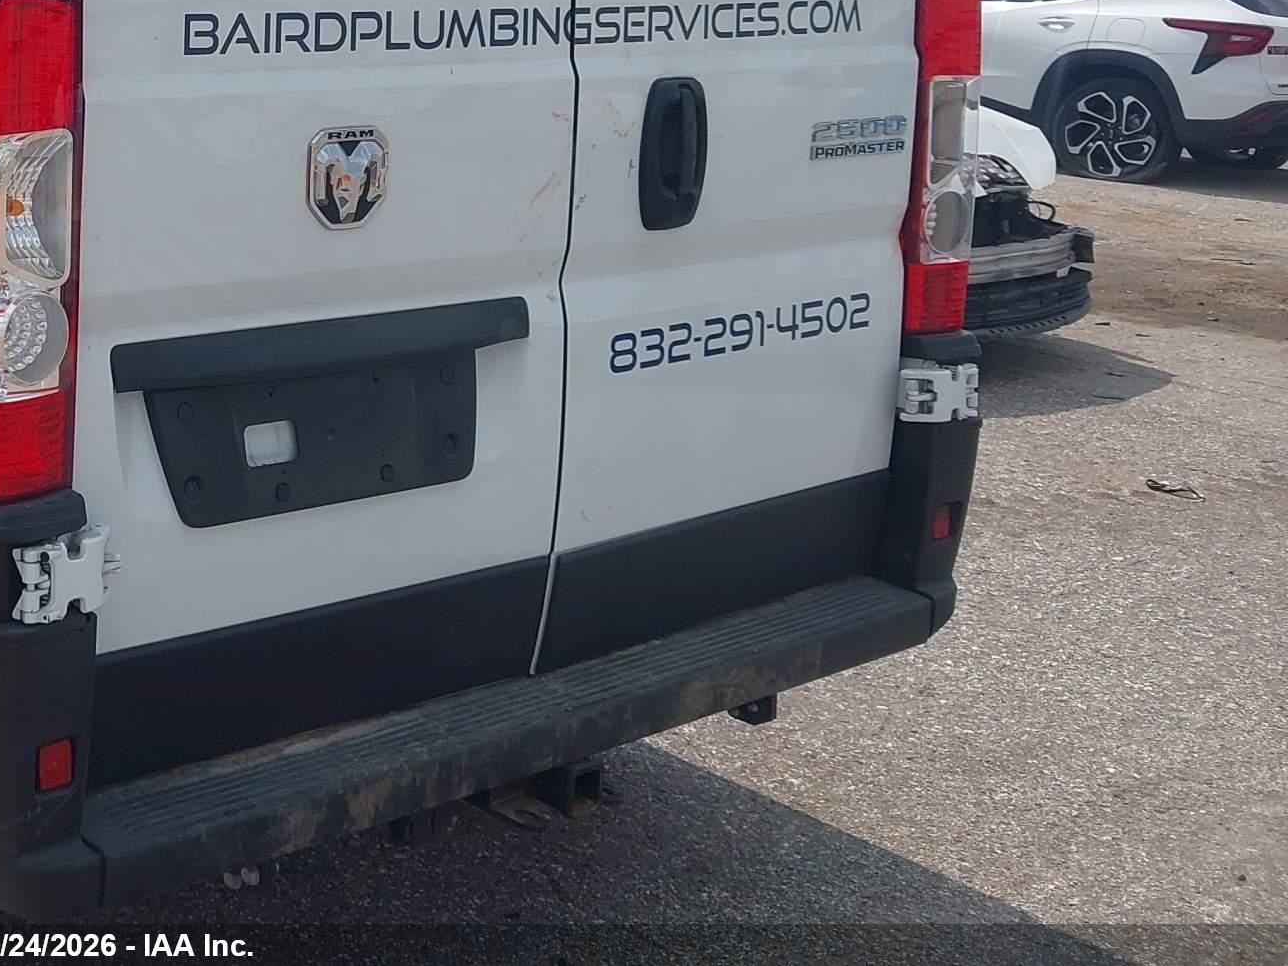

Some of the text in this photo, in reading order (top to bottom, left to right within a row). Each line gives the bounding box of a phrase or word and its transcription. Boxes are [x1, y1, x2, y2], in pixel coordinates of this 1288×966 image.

[327, 129, 375, 140] RAM
[812, 114, 907, 143] 2500
[609, 292, 872, 374] 832-291-4502
